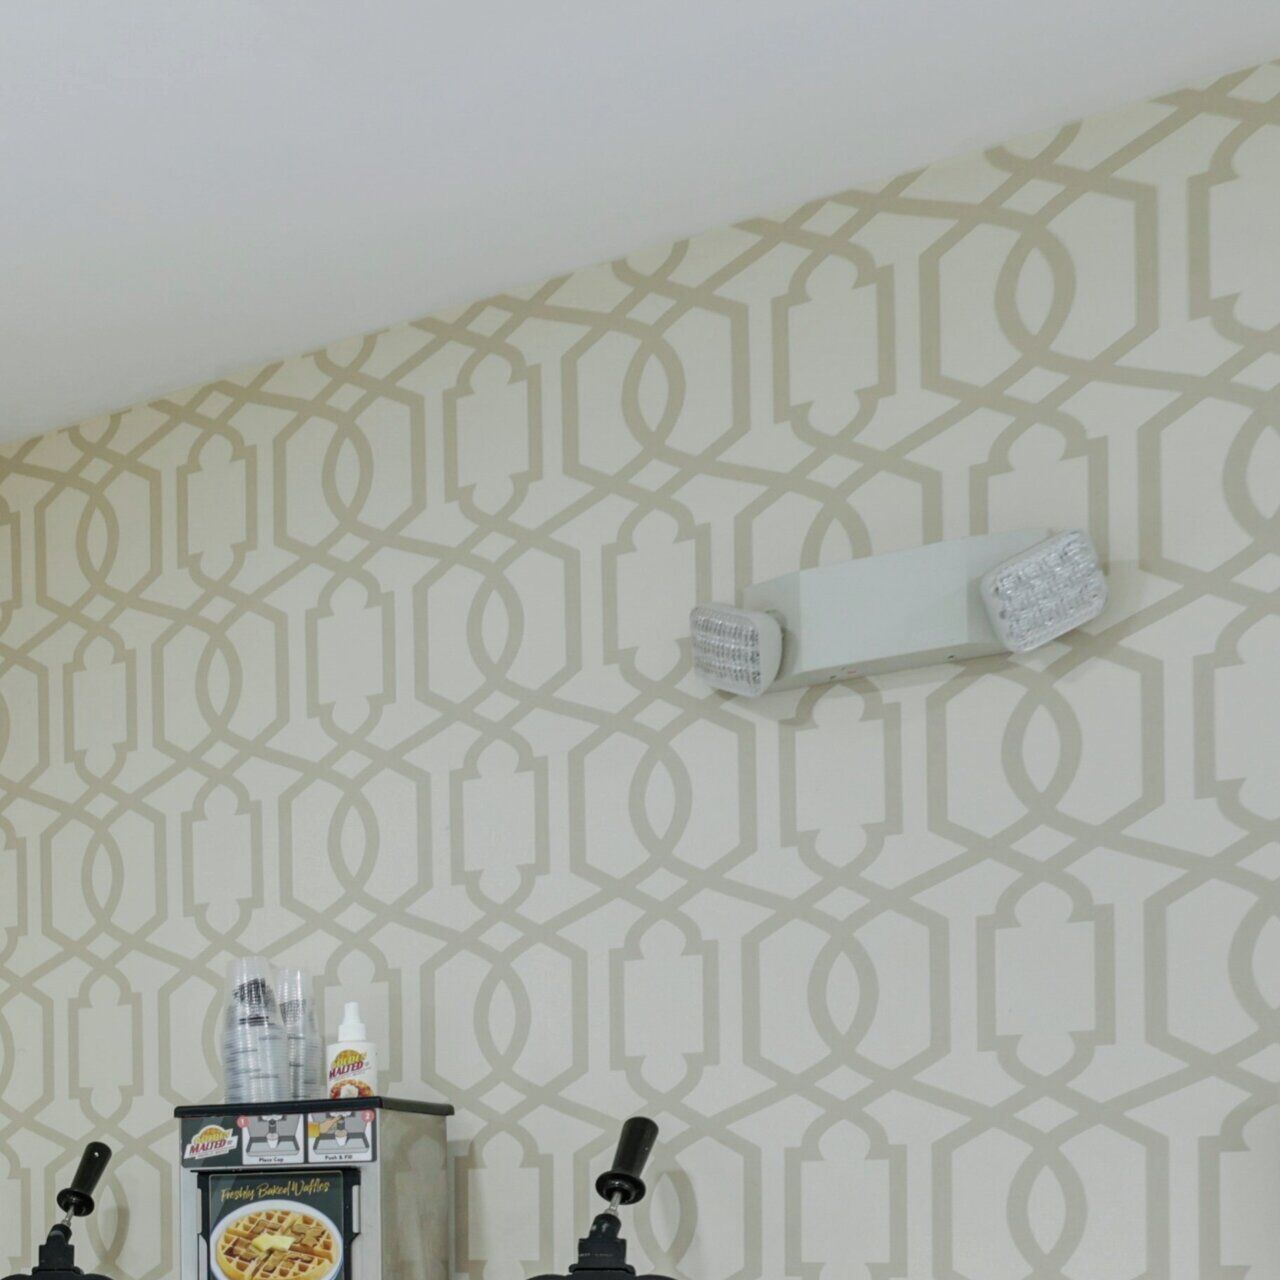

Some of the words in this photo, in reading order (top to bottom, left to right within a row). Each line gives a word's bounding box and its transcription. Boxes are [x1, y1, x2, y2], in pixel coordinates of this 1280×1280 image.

[329, 1059, 364, 1080] MALTED
[190, 1138, 227, 1154] MALTED
[221, 1183, 255, 1202] Freshly
[256, 1180, 291, 1199] Baked
[291, 1177, 331, 1197] Waffles
